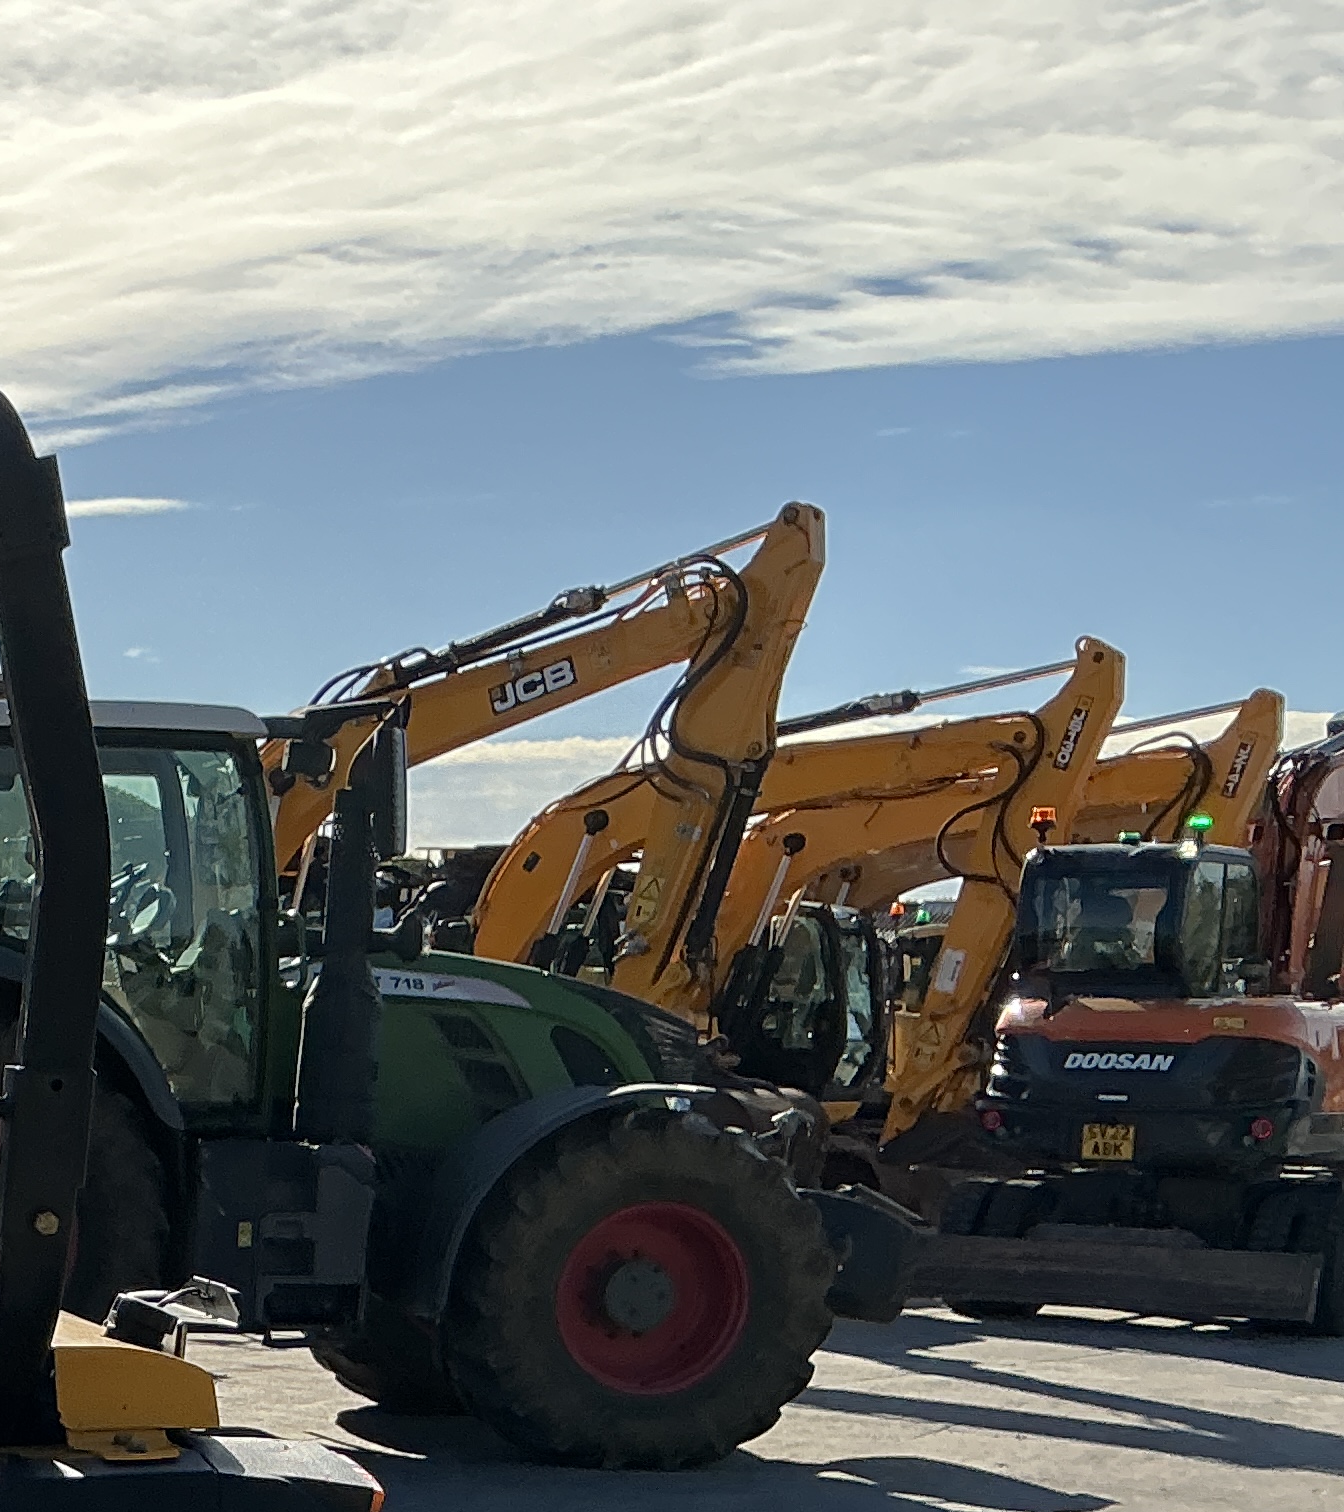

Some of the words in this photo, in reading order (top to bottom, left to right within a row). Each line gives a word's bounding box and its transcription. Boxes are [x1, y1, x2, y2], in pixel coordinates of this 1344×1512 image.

[493, 660, 575, 712] JCB
[390, 976, 424, 990] 718
[1064, 1053, 1175, 1071] DOOSAN
